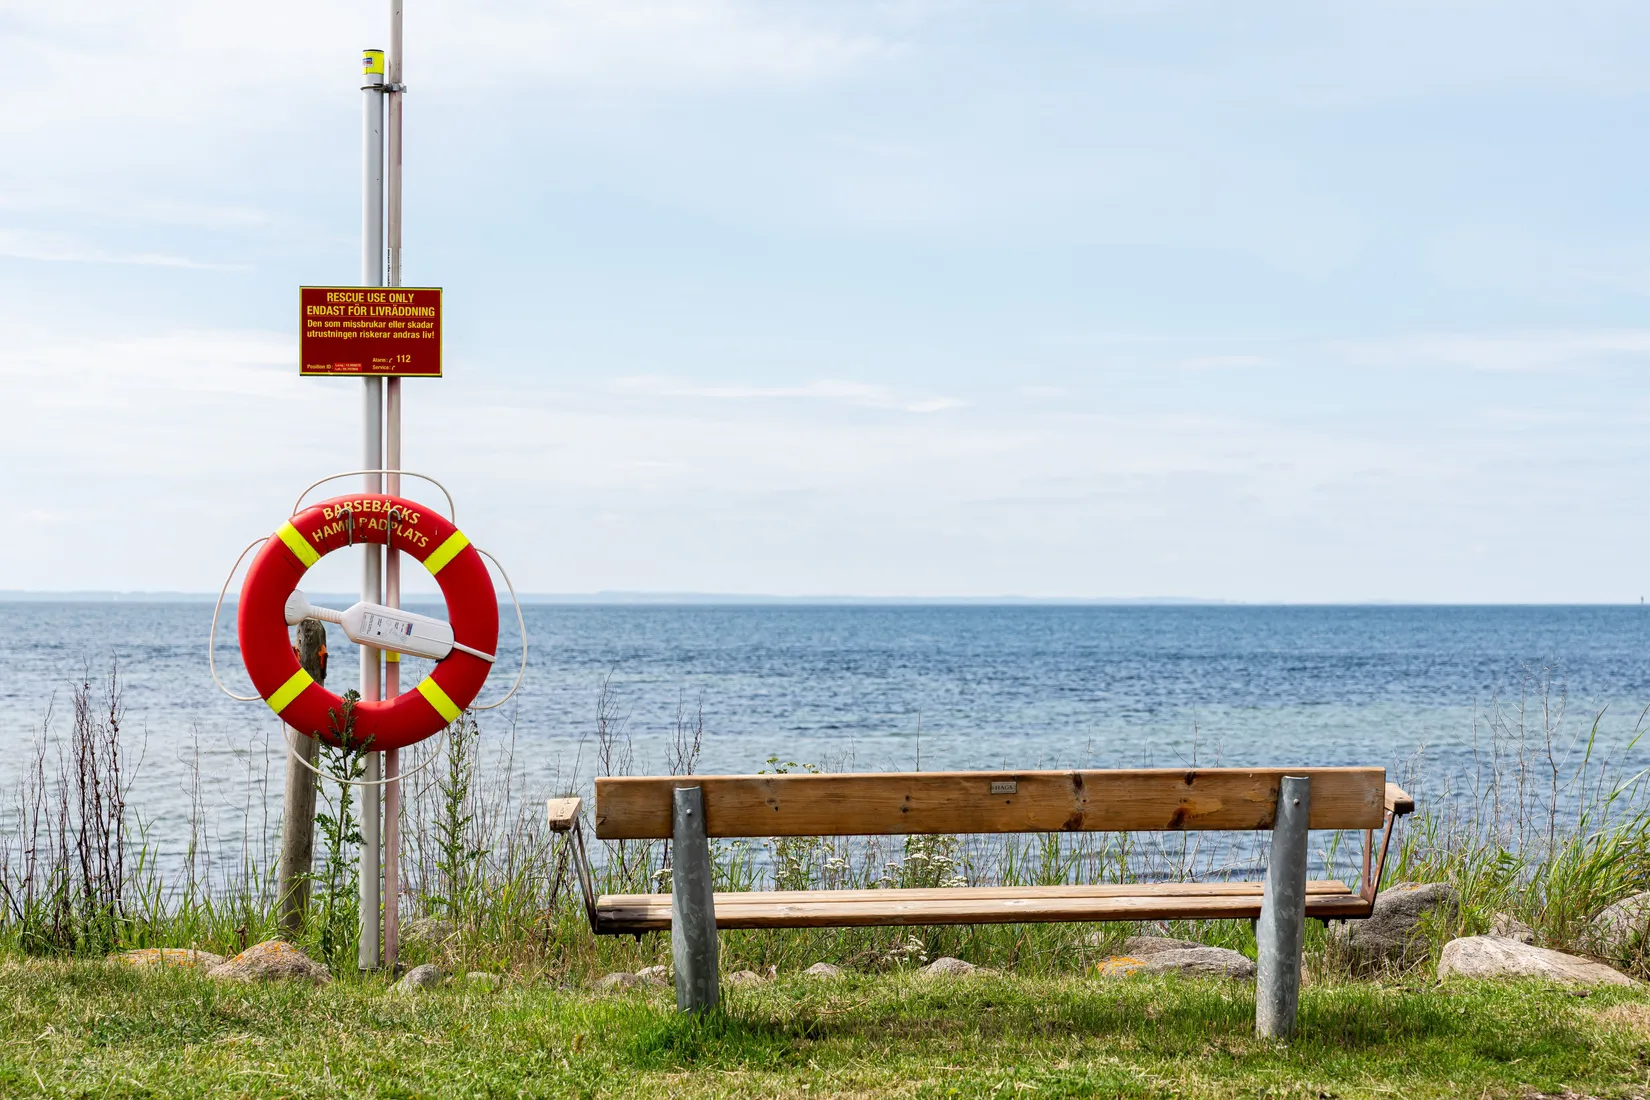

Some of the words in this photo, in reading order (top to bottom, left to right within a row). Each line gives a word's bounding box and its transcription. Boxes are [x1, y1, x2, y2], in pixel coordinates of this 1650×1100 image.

[327, 292, 364, 302] RESCUE
[367, 293, 386, 302] USE
[389, 293, 414, 303] ONLY
[307, 306, 345, 316] ENDAST
[348, 304, 367, 316] FÖR
[370, 304, 435, 317] LIVRÄDDNING
[343, 320, 386, 328] missbrukar
[388, 320, 405, 328] eller
[307, 330, 357, 339] utrustningen
[396, 354, 411, 363] 112
[322, 500, 420, 524] BARSEBÄCKS
